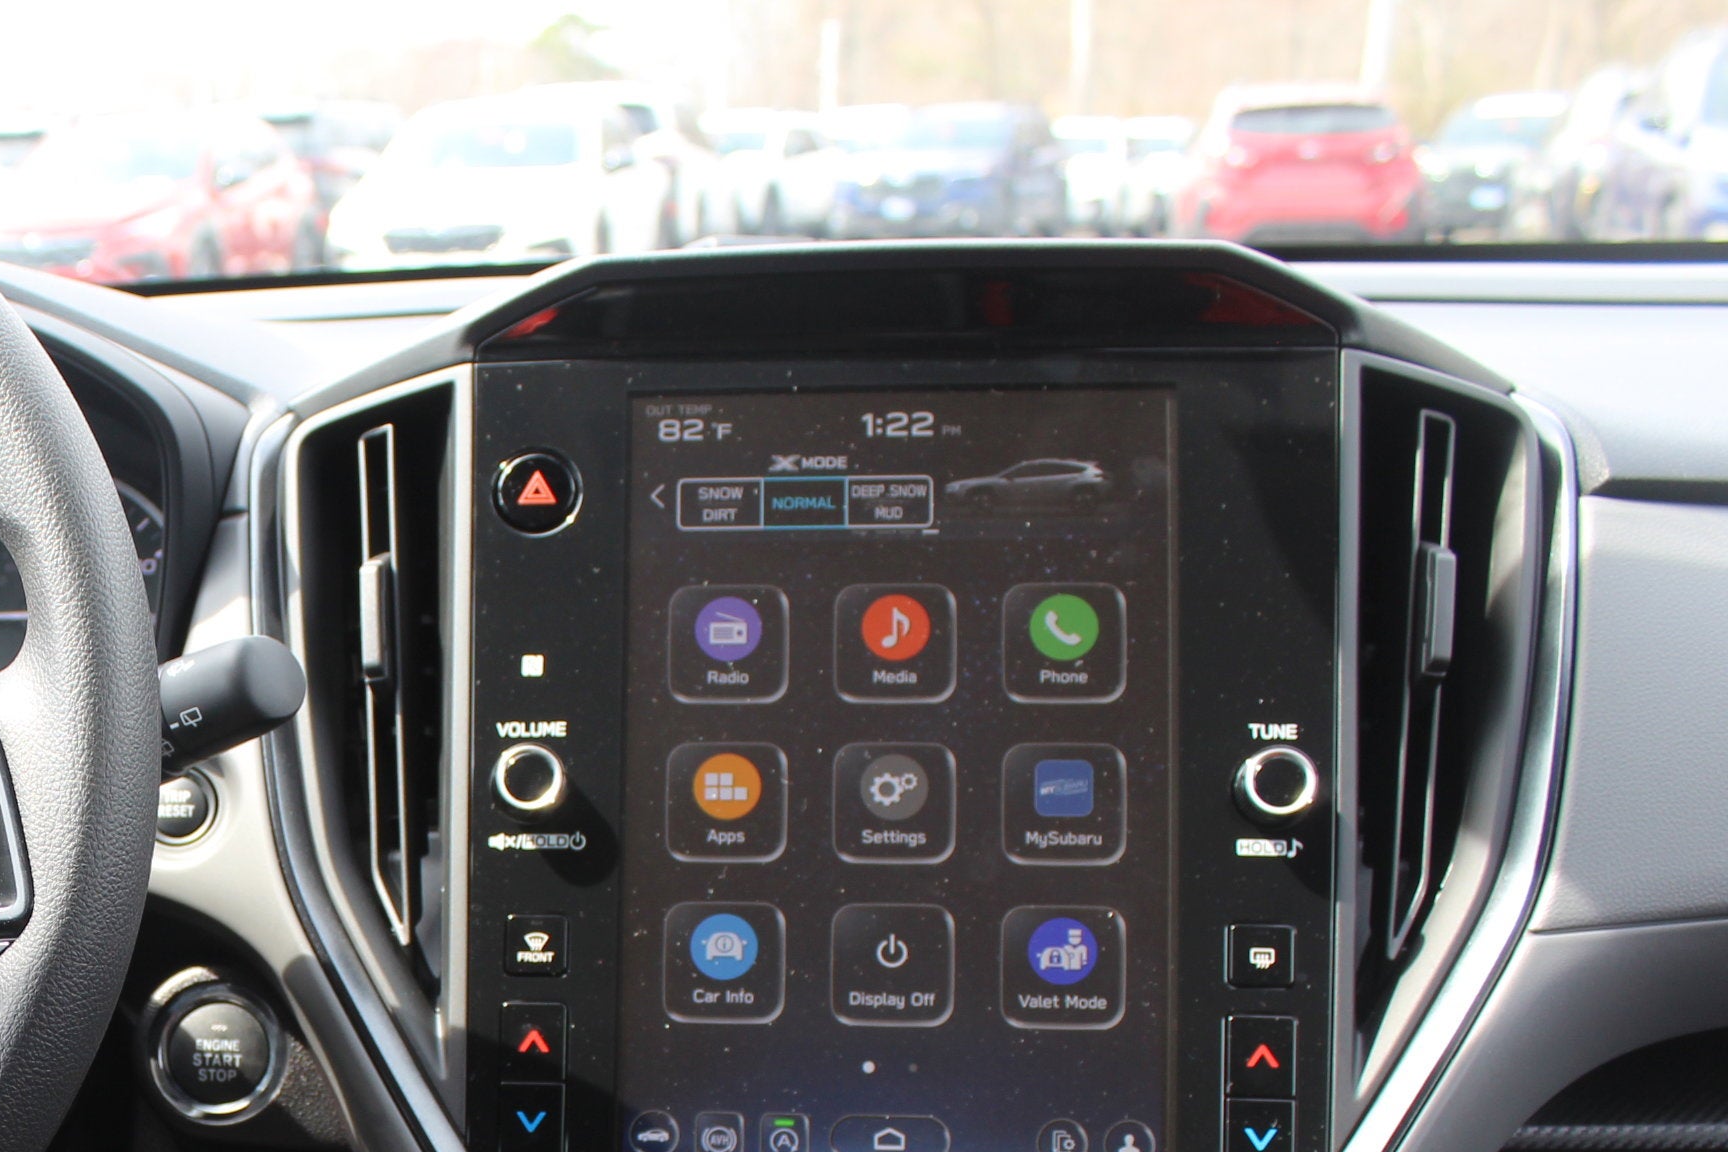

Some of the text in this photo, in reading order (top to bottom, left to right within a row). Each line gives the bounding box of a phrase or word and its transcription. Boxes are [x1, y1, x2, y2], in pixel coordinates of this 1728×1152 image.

[645, 404, 713, 416] OUT TEMP
[658, 419, 705, 441] 82
[861, 411, 962, 437] 1:22 PM
[802, 456, 848, 470] MODE
[698, 487, 744, 500] SNOW
[851, 484, 928, 498] DEEP SNOW
[772, 497, 836, 511] NORMAL
[702, 508, 738, 522] DIRT
[874, 506, 904, 520] MUD
[707, 669, 750, 684] Radio
[873, 669, 918, 684] Media
[1039, 669, 1089, 684] Phone
[496, 721, 568, 739] VOLUME
[1248, 723, 1299, 741] TUNE
[157, 804, 196, 818] RESET
[707, 829, 746, 847] Apps
[861, 829, 927, 847] Settings
[1025, 831, 1103, 849] MySubaru
[517, 951, 555, 963] FRONT
[692, 987, 754, 1004] Car Info
[849, 991, 935, 1010] Display Off
[1019, 993, 1107, 1010] Valet Mode
[195, 1038, 240, 1052] ENGINE
[193, 1053, 242, 1069] START
[198, 1069, 237, 1082] STOP
[710, 1134, 729, 1146] AVH
